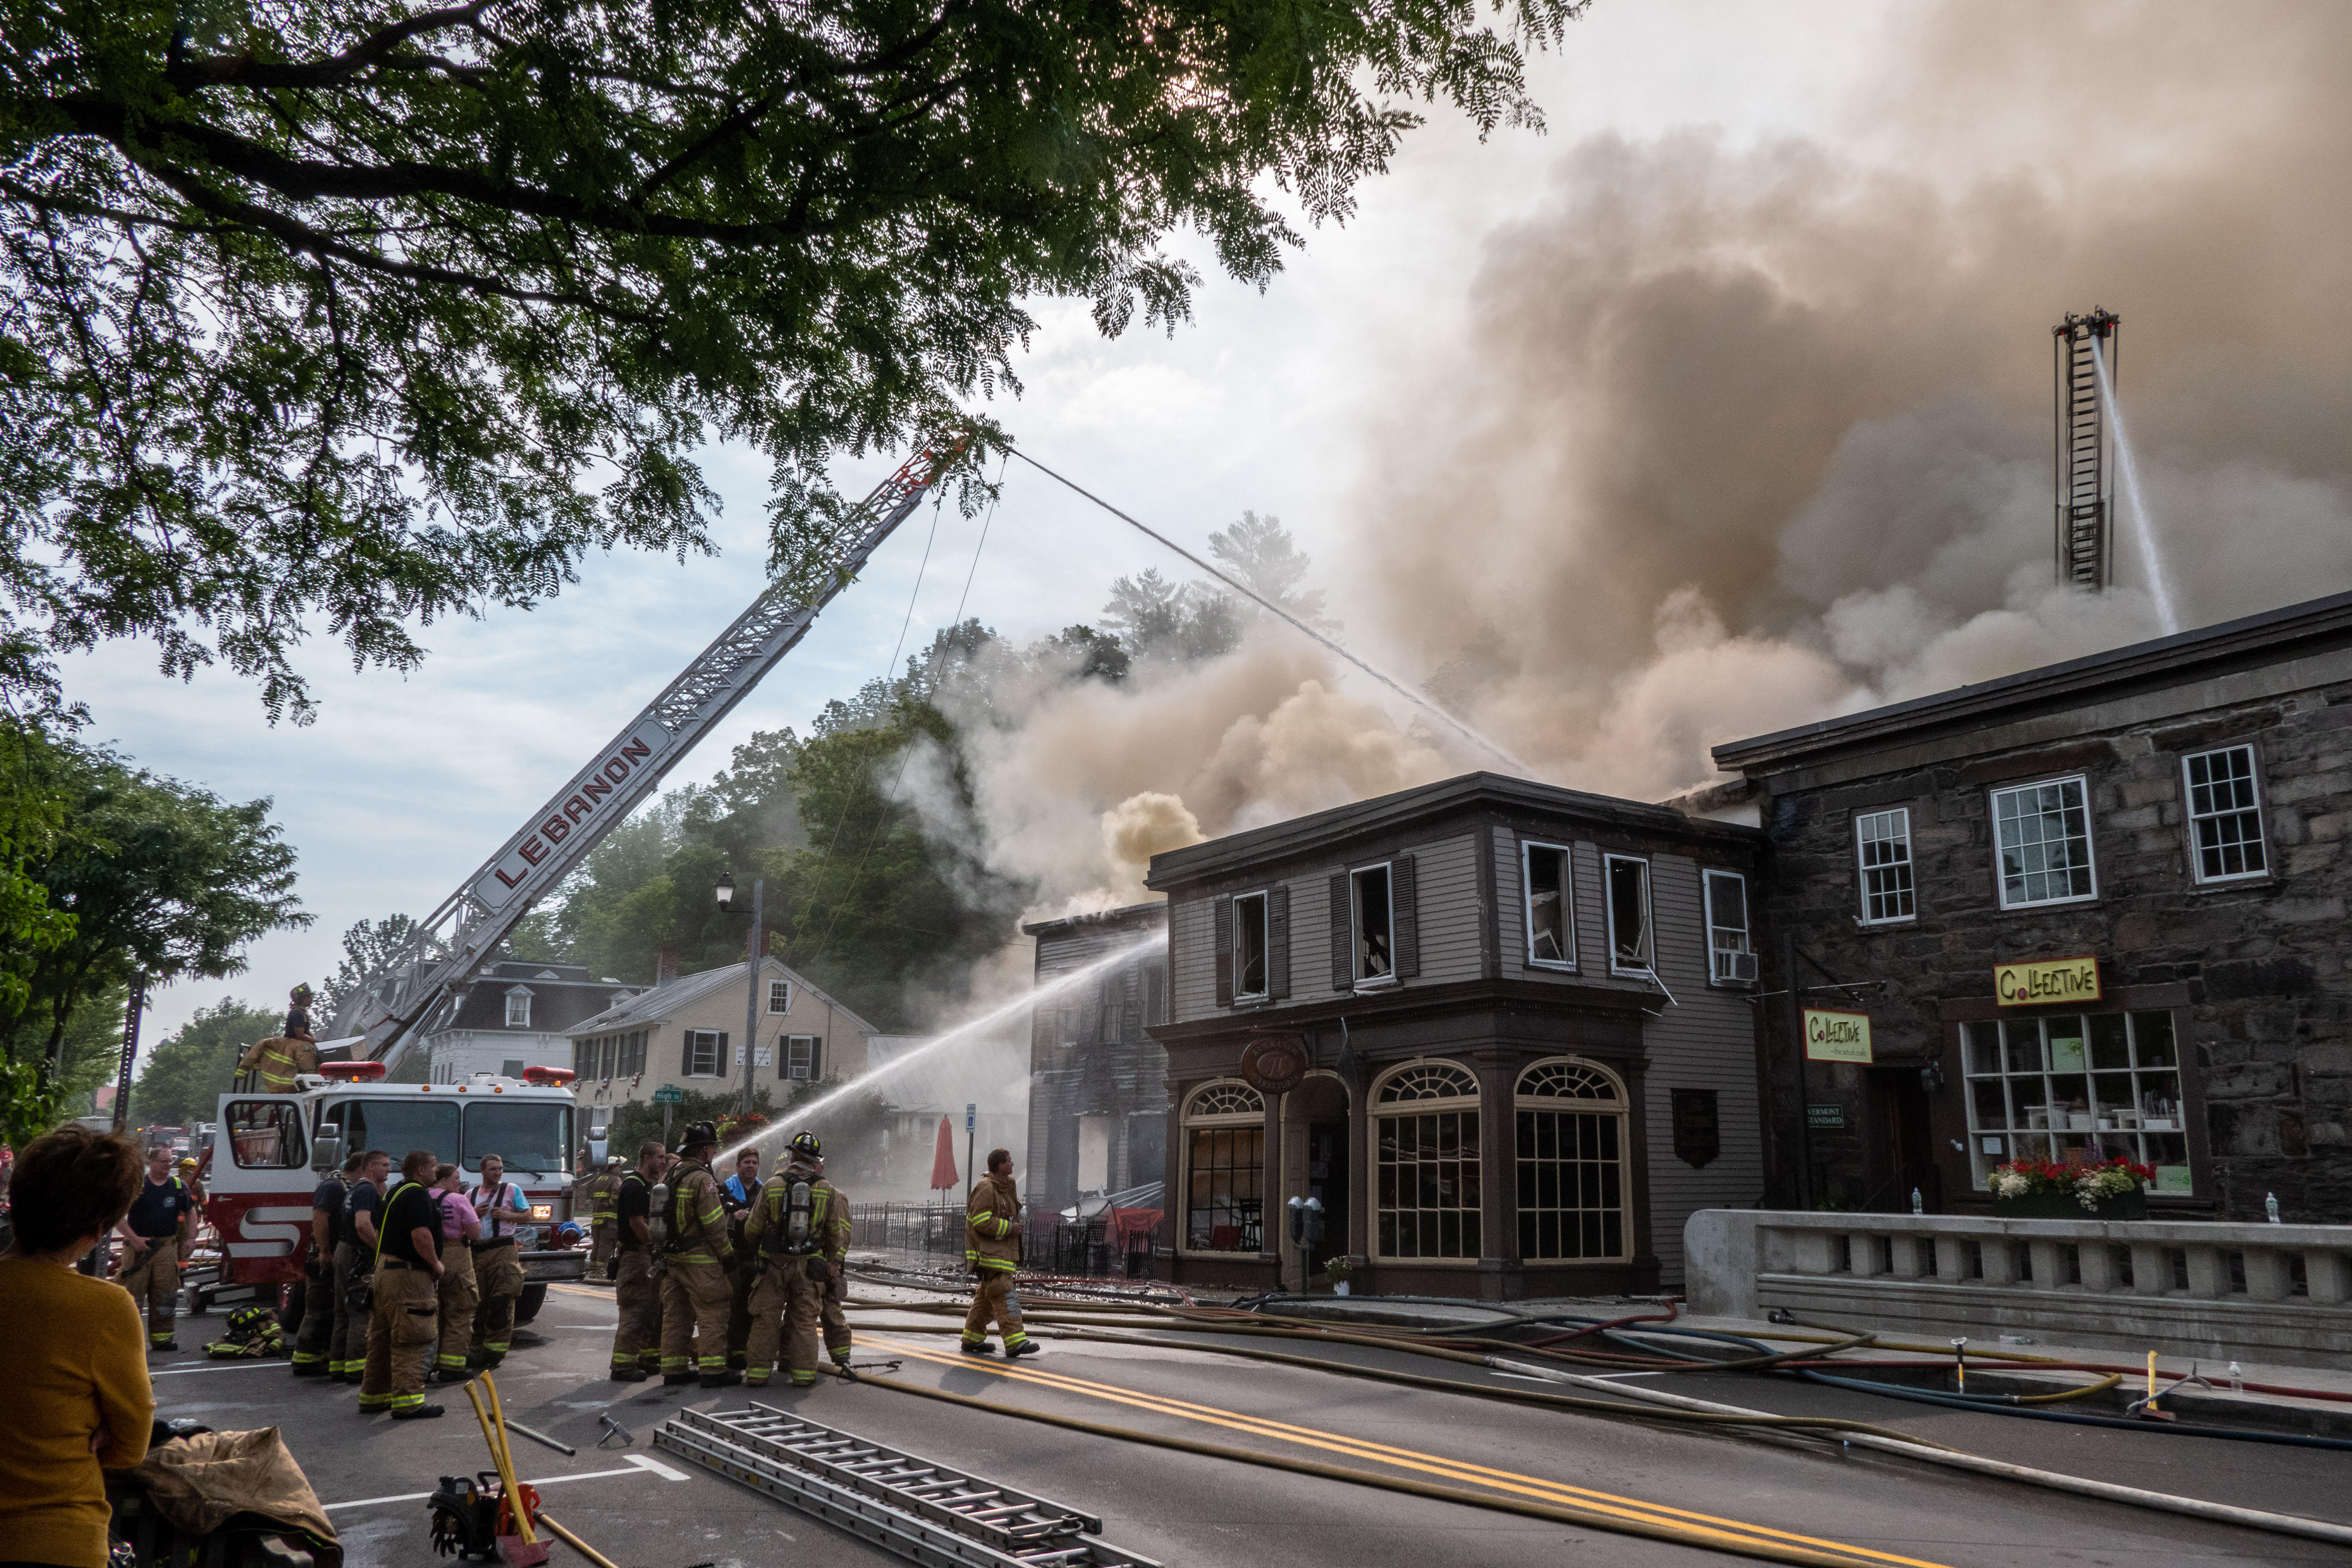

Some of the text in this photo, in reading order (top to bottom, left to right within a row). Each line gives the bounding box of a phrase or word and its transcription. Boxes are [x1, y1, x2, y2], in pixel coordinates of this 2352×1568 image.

[495, 736, 651, 889] LEBANON
[1253, 1041, 1275, 1057] BRICK
[657, 1092, 672, 1100] High
